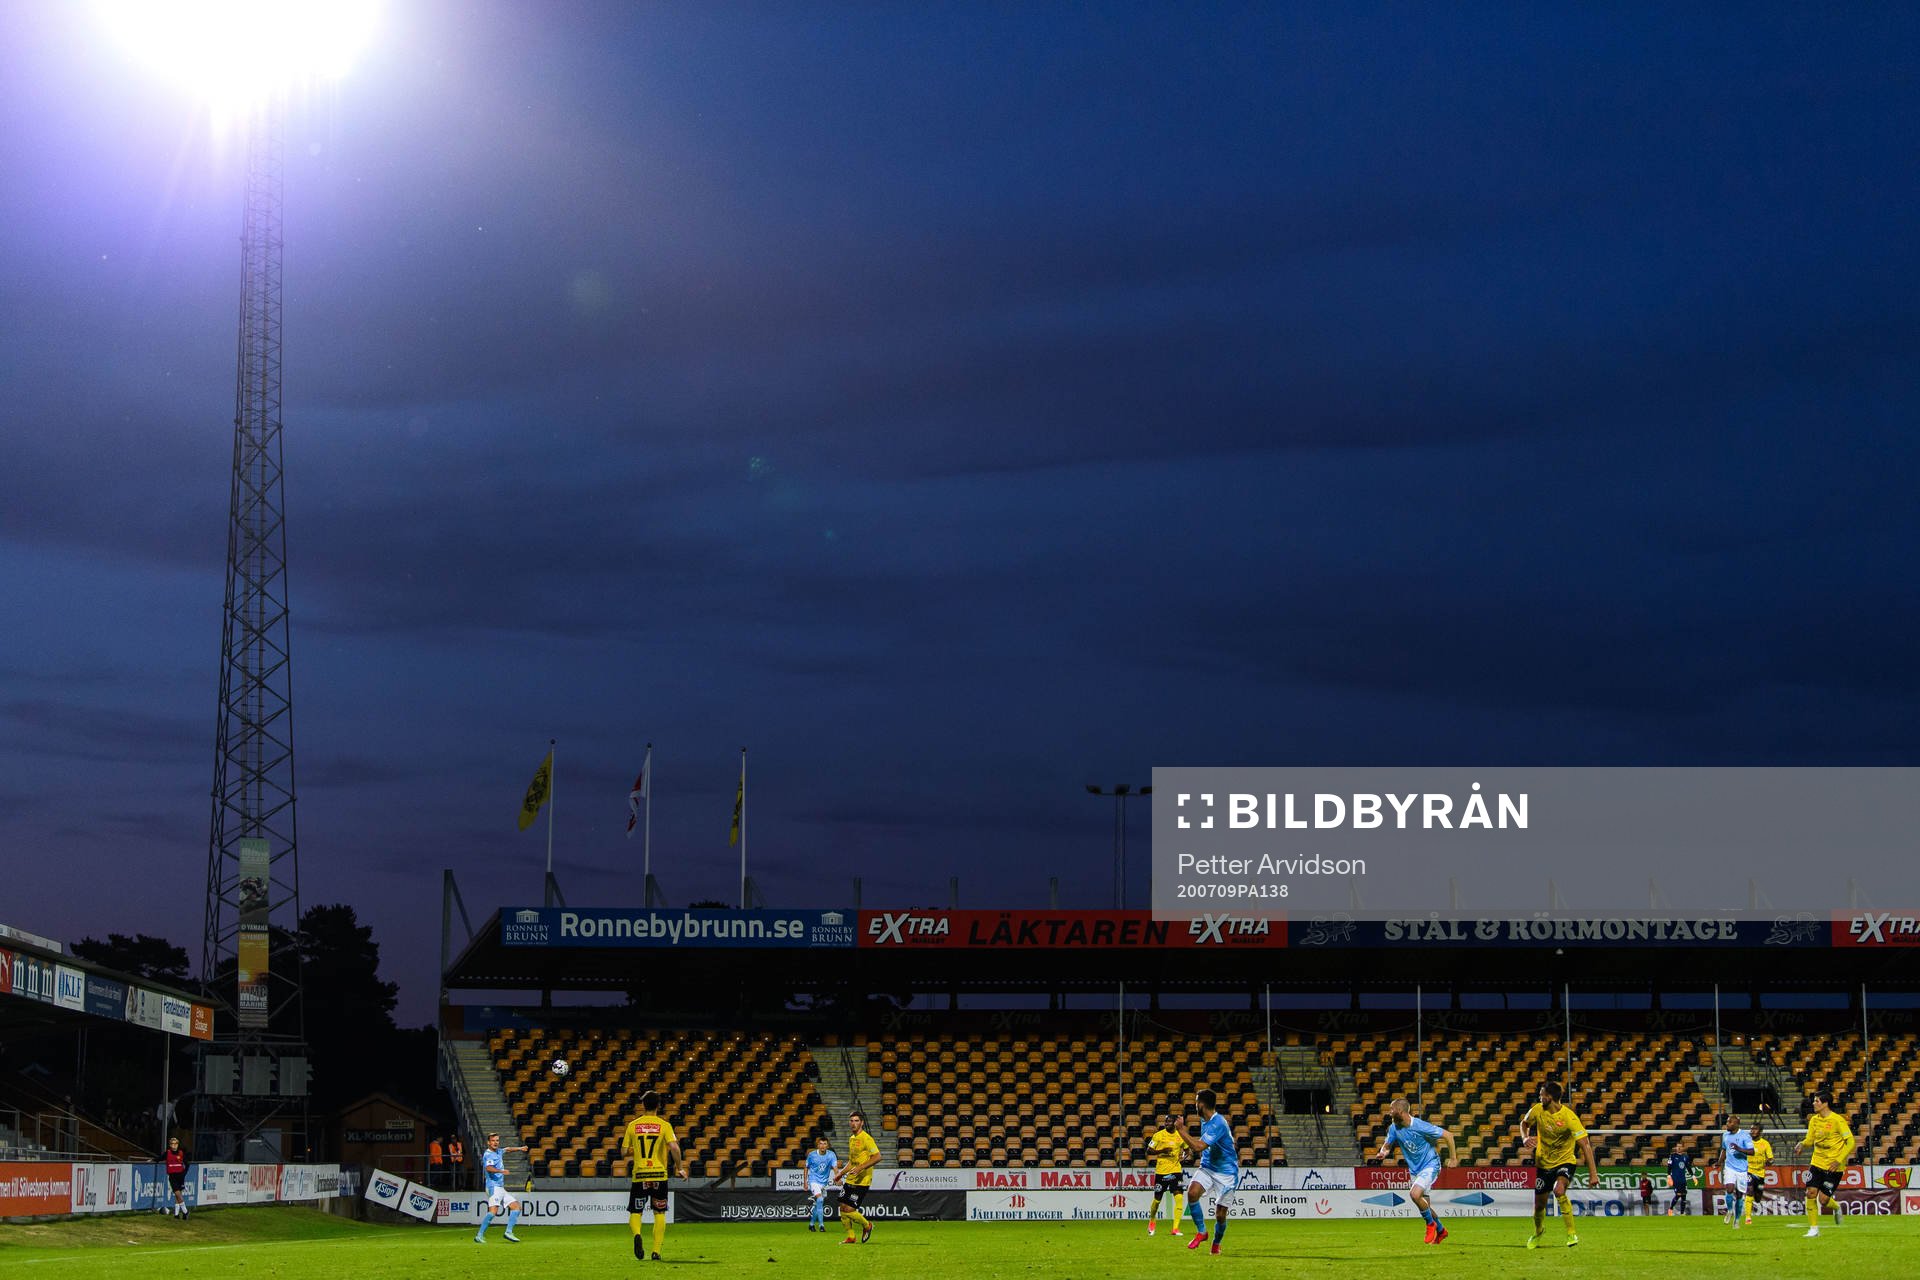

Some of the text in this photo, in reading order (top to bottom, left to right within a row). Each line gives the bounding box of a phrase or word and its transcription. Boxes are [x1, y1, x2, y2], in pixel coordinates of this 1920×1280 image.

[506, 924, 549, 932] RONNEBY
[561, 912, 804, 944] Ronnebybrunn.se
[812, 926, 853, 934] RONNEBY
[868, 913, 950, 944] EXTRA
[968, 913, 1169, 945] LÄKTAREN
[1188, 912, 1270, 944] EXTRA
[1384, 912, 1738, 940] STÅL & RÖRMONTAGE
[506, 932, 548, 941] BRUNN
[812, 934, 853, 942] BRUNN
[638, 1136, 658, 1159] 17
[1371, 1169, 1411, 1180] march
[1467, 1169, 1527, 1182] marching
[1259, 1194, 1307, 1204] Allt inom
[451, 1202, 470, 1211] BLT
[721, 1205, 833, 1217] HUSVAGNS-EXO
[1241, 1208, 1256, 1216] AB
[1271, 1205, 1296, 1216] skog
[1027, 1210, 1063, 1219] BYGGER
[1128, 1210, 1163, 1219] BYGGR
